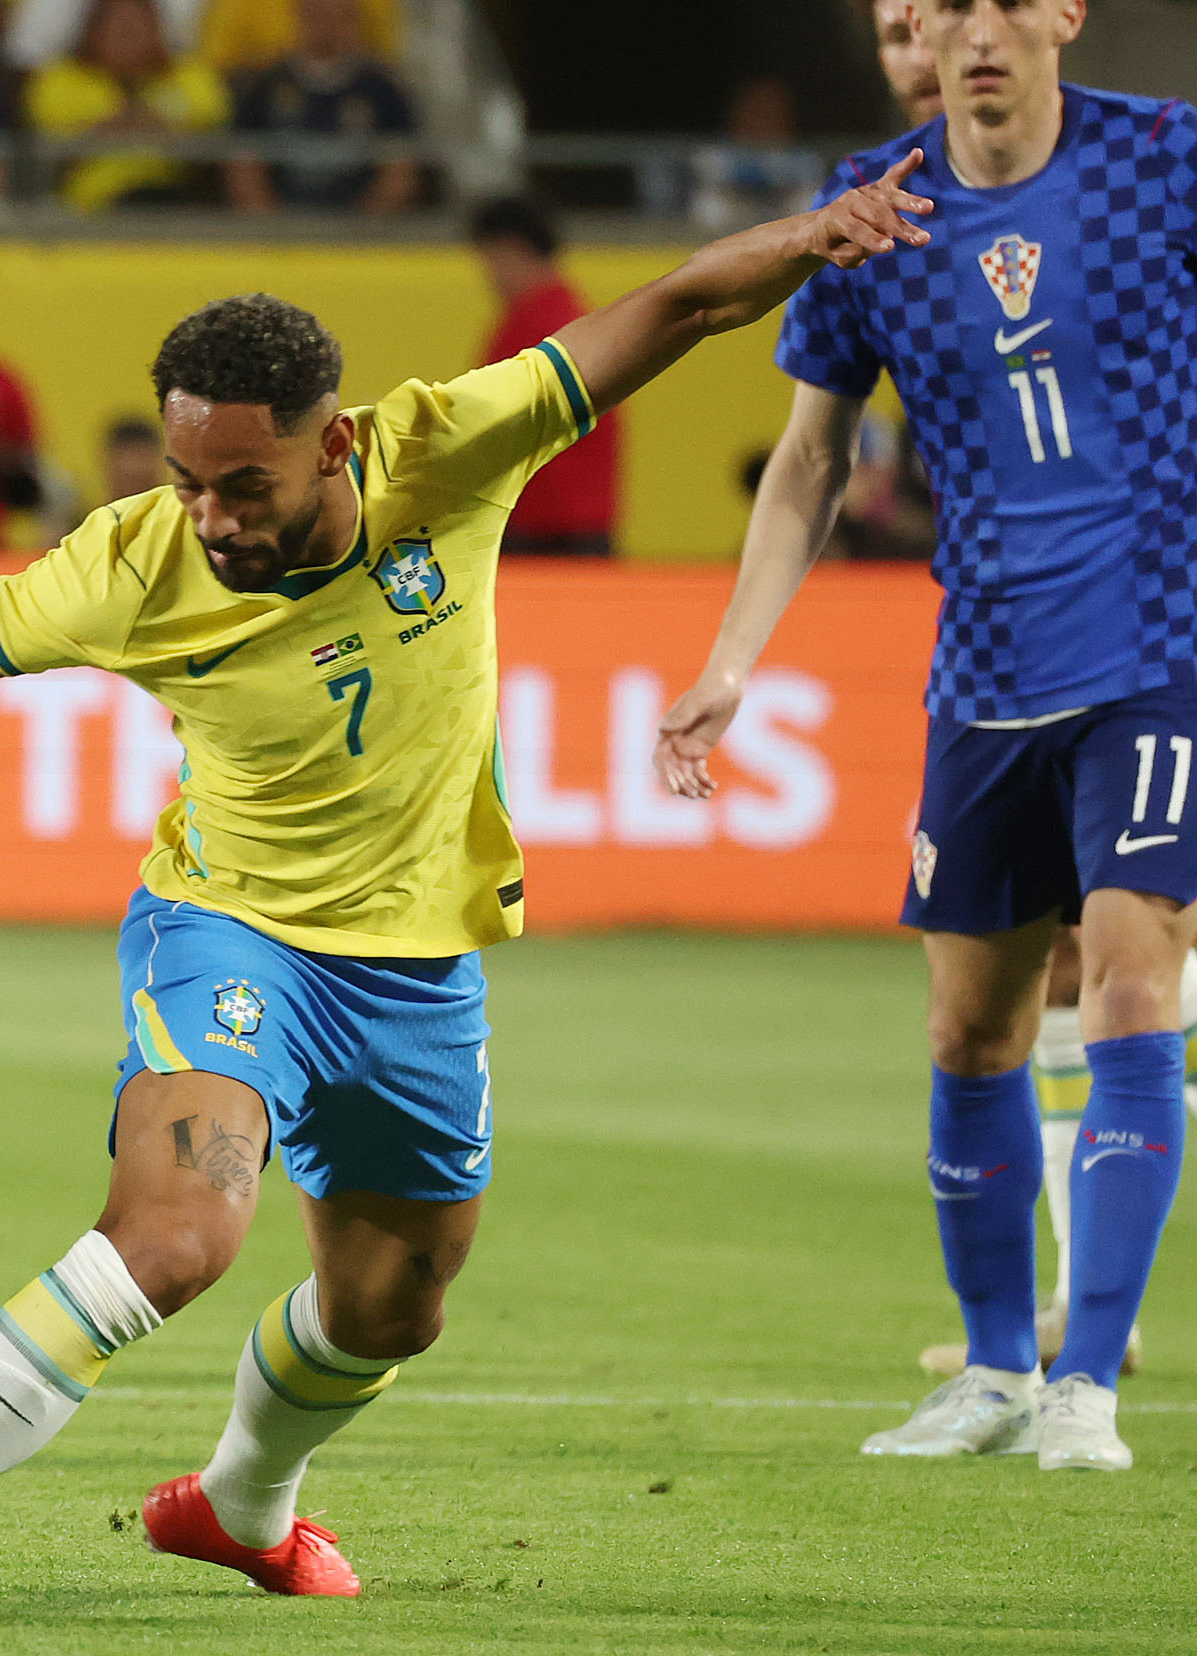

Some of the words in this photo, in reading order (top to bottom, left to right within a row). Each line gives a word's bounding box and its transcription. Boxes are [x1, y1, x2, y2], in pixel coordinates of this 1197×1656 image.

[1008, 366, 1073, 463] 11
[397, 566, 420, 585] CBF
[398, 601, 463, 645] BRASIL
[326, 667, 373, 757] 7
[1132, 733, 1193, 824] 11
[205, 1032, 258, 1058] BRASIL
